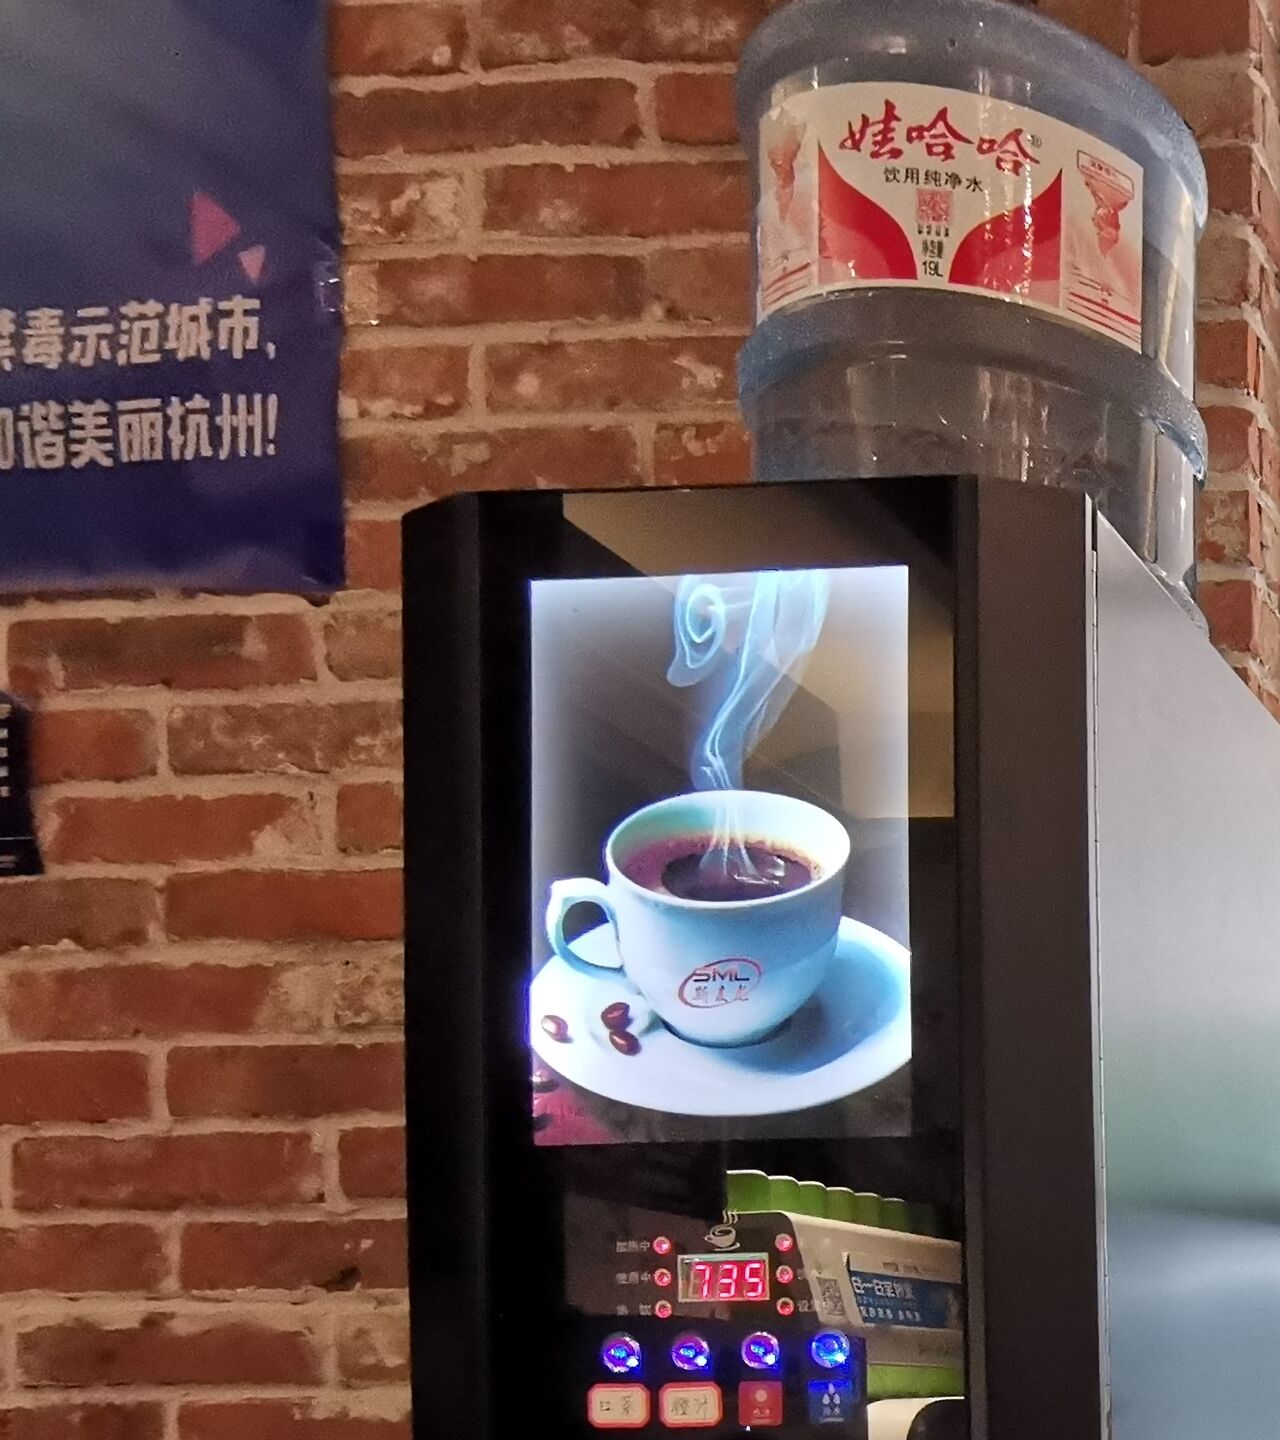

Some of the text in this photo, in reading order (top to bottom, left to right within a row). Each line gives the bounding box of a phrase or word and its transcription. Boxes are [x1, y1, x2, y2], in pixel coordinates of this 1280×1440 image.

[838, 98, 1041, 177] 娃哈哈
[882, 165, 984, 194] 饮用纯净水
[921, 261, 944, 278] 19L
[692, 967, 751, 983] SML
[693, 1262, 764, 1299] 735
